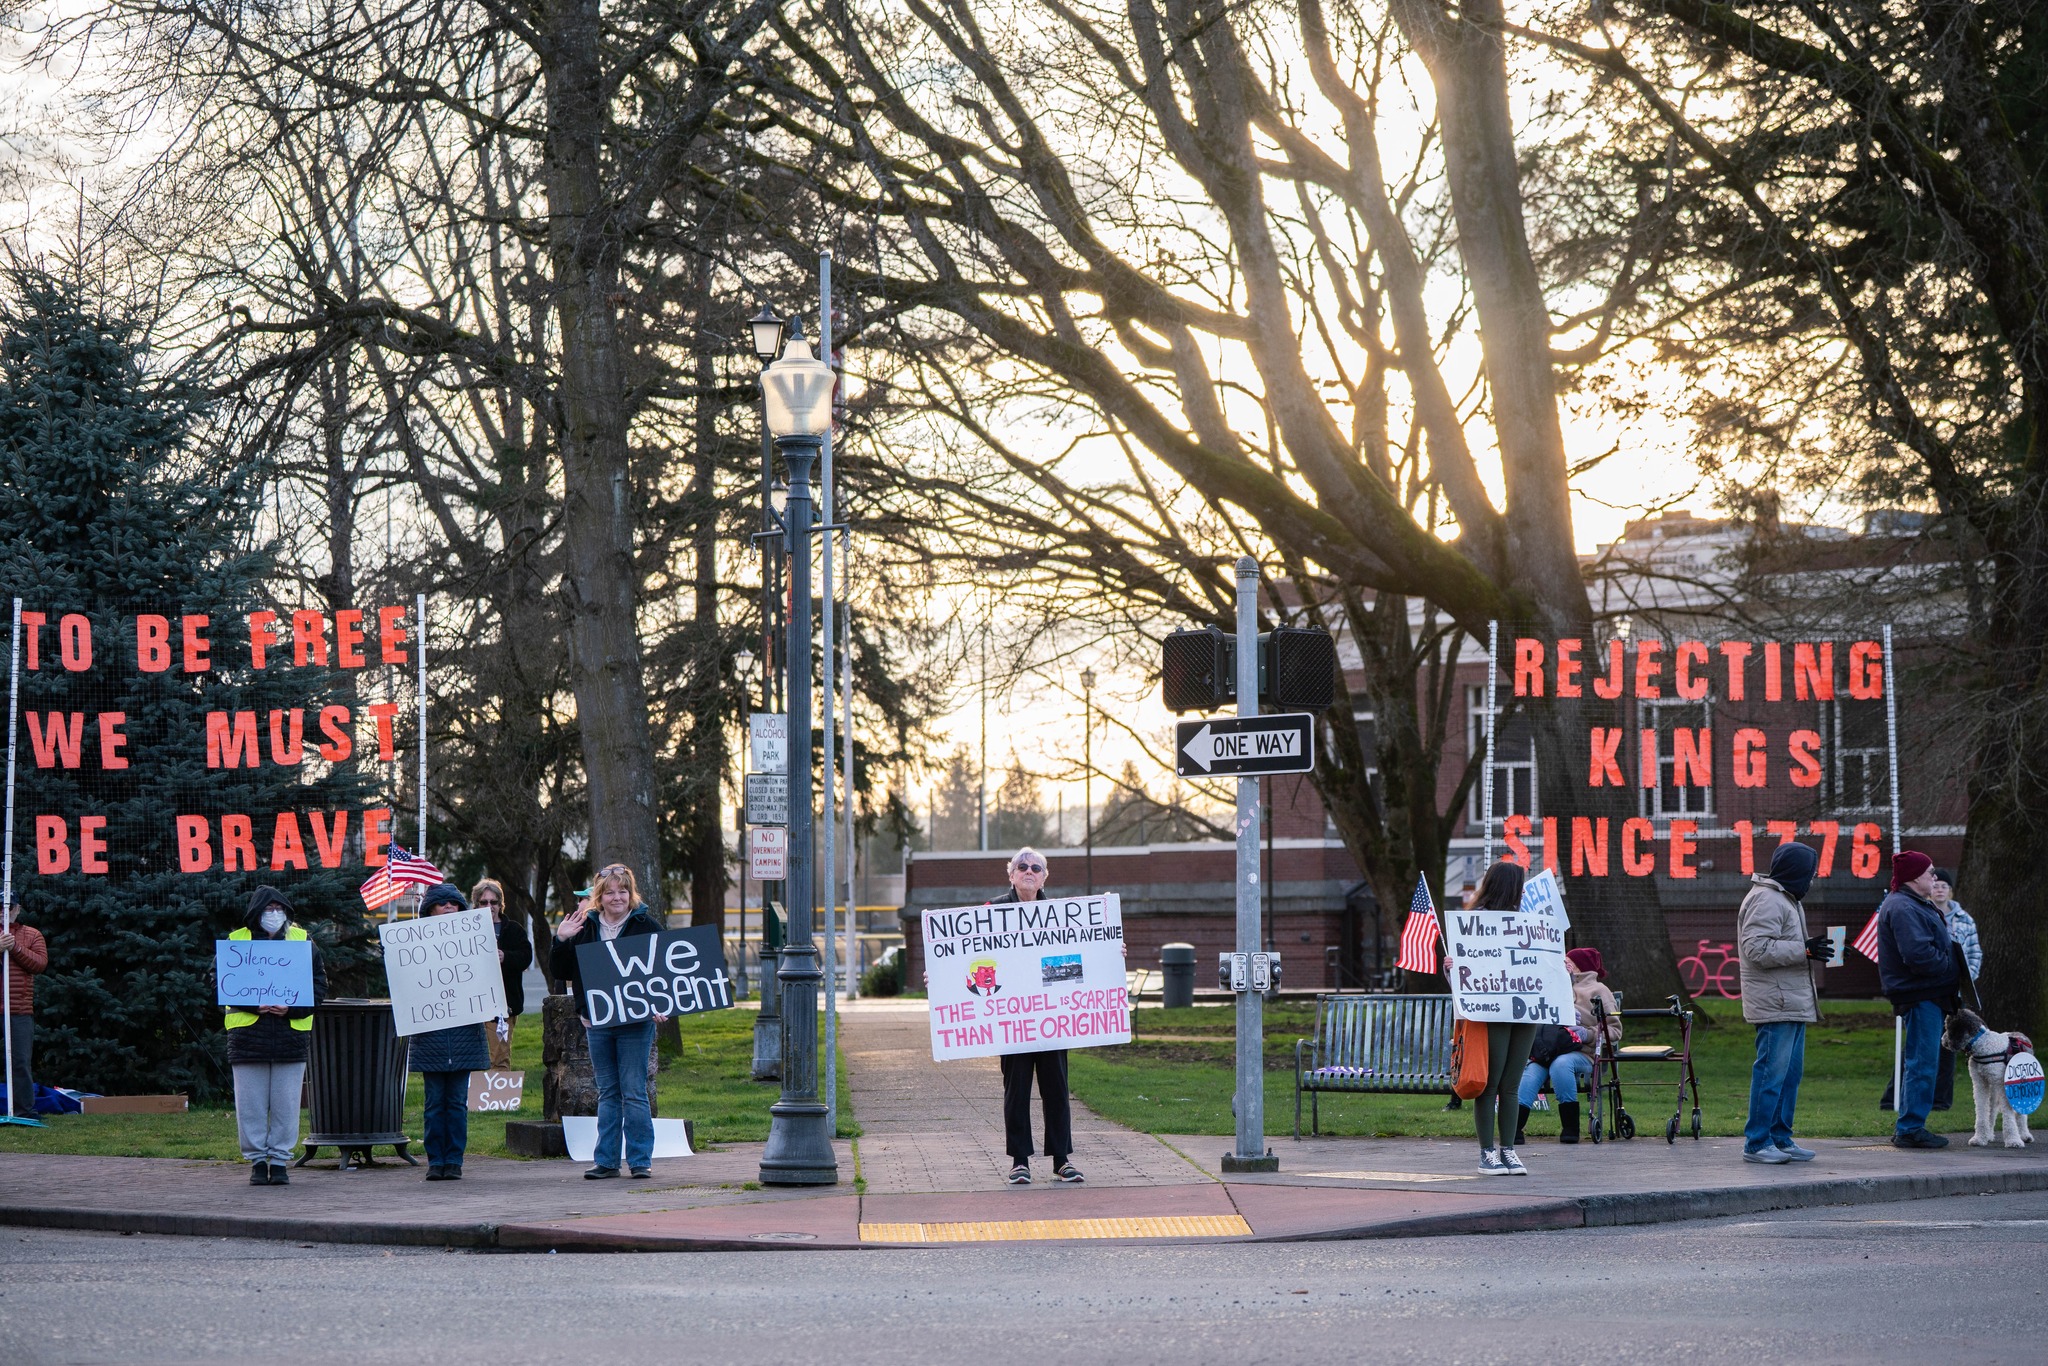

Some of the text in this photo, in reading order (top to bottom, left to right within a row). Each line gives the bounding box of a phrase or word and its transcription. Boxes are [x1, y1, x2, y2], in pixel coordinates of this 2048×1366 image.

[21, 606, 408, 673] TO BE FREE
[1514, 638, 1883, 701] REJECTING
[25, 703, 399, 769] WE MUST
[755, 729, 786, 739] ALCOHOL
[765, 718, 776, 728] NO
[762, 751, 780, 760] PARK
[767, 740, 774, 749] IN
[1213, 732, 1295, 757] ONE WAY
[1589, 727, 1822, 788] KINGS
[36, 807, 392, 874] BE BRAVE
[761, 832, 775, 842] NO
[1501, 814, 1699, 879] SINCE
[385, 916, 482, 944] CONGRESS
[929, 901, 1103, 939] NIGHTMARE
[1456, 915, 1561, 949] When Injustice
[226, 944, 292, 968] Silence
[398, 934, 494, 967] DO YOUR
[605, 933, 701, 978] We
[934, 926, 1123, 958] ON PENNSYLVANIA AVENUE
[1456, 942, 1537, 966] Becomes Law
[221, 973, 299, 1005] Complicity
[418, 963, 474, 989] JOB
[1459, 966, 1543, 992] Resistance
[440, 989, 456, 999] OR
[935, 1000, 976, 1024] THE
[983, 994, 1058, 1017] SEQUEL
[1069, 987, 1129, 1011] SCARIER
[411, 1001, 458, 1023] LOSE
[1512, 996, 1560, 1024] Duty
[937, 1009, 1130, 1048] THAN THE ORIGINAL
[484, 1072, 523, 1091] You
[2008, 1062, 2042, 1079] DICTATOR
[478, 1092, 521, 1111] Save
